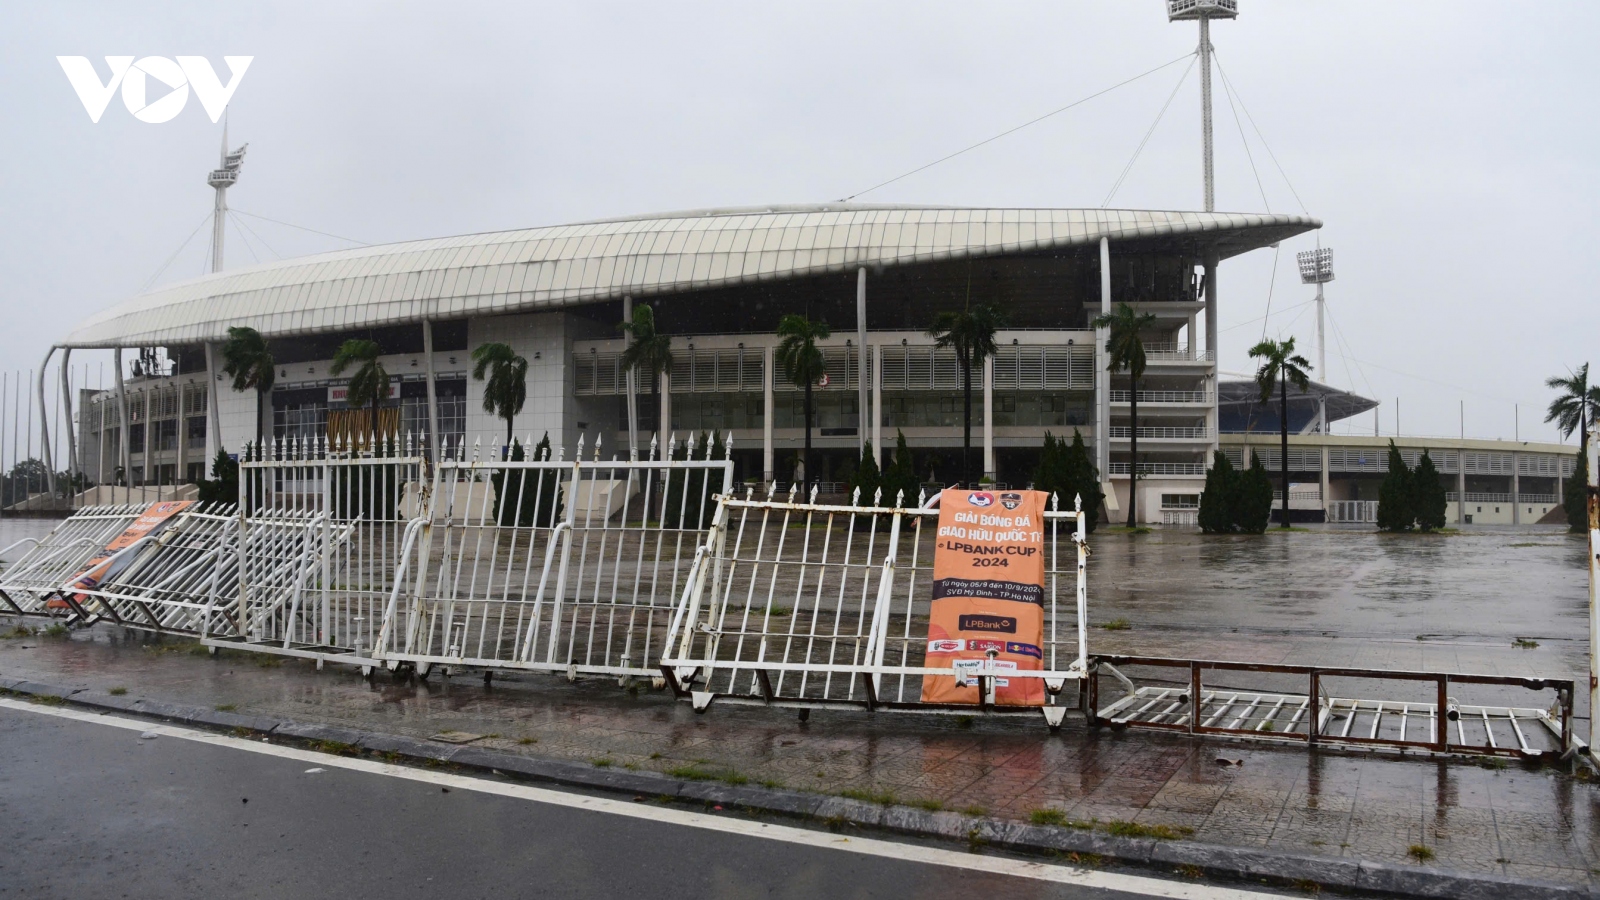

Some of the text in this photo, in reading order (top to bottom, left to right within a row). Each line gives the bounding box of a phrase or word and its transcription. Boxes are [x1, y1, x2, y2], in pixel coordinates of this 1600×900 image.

[954, 511, 1031, 527] GIẢI BÓNG ĐÁ
[939, 526, 966, 539] GIAO
[968, 528, 993, 542] HỮU
[995, 528, 1028, 543] QUỐC
[946, 541, 1036, 557] LPBANK CUP
[972, 558, 1009, 568] 2024
[963, 589, 975, 597] Mỹ
[1022, 595, 1036, 603] Nội
[965, 620, 1001, 630] LPBank
